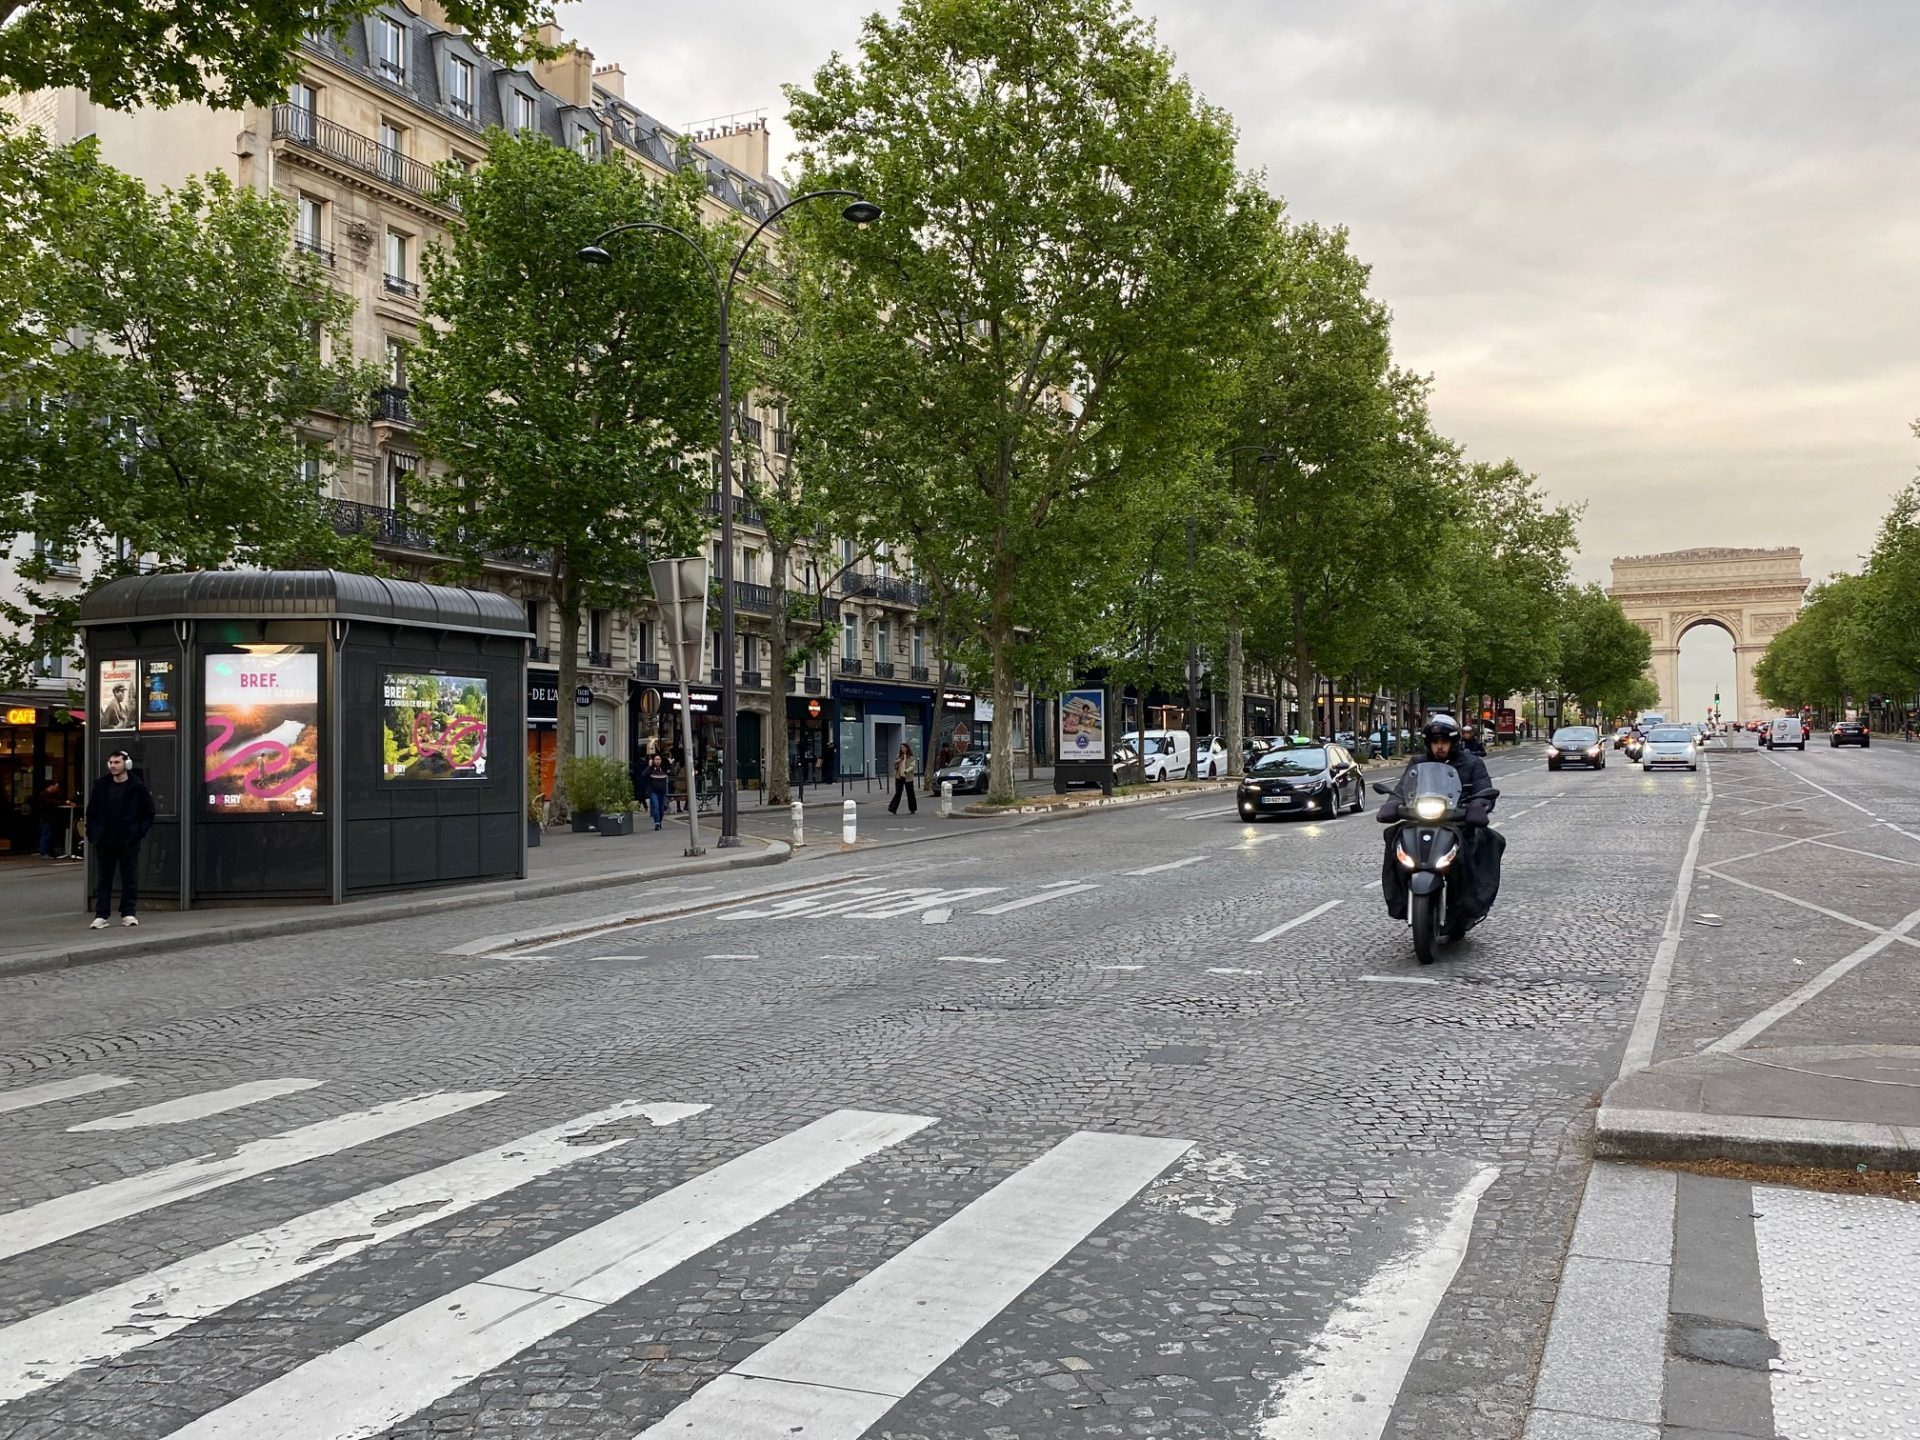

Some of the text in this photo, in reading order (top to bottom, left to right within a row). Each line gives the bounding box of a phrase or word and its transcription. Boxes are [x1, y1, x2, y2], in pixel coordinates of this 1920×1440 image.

[240, 673, 279, 688] BREF.
[384, 686, 407, 699] BREF.
[533, 688, 546, 701] DE
